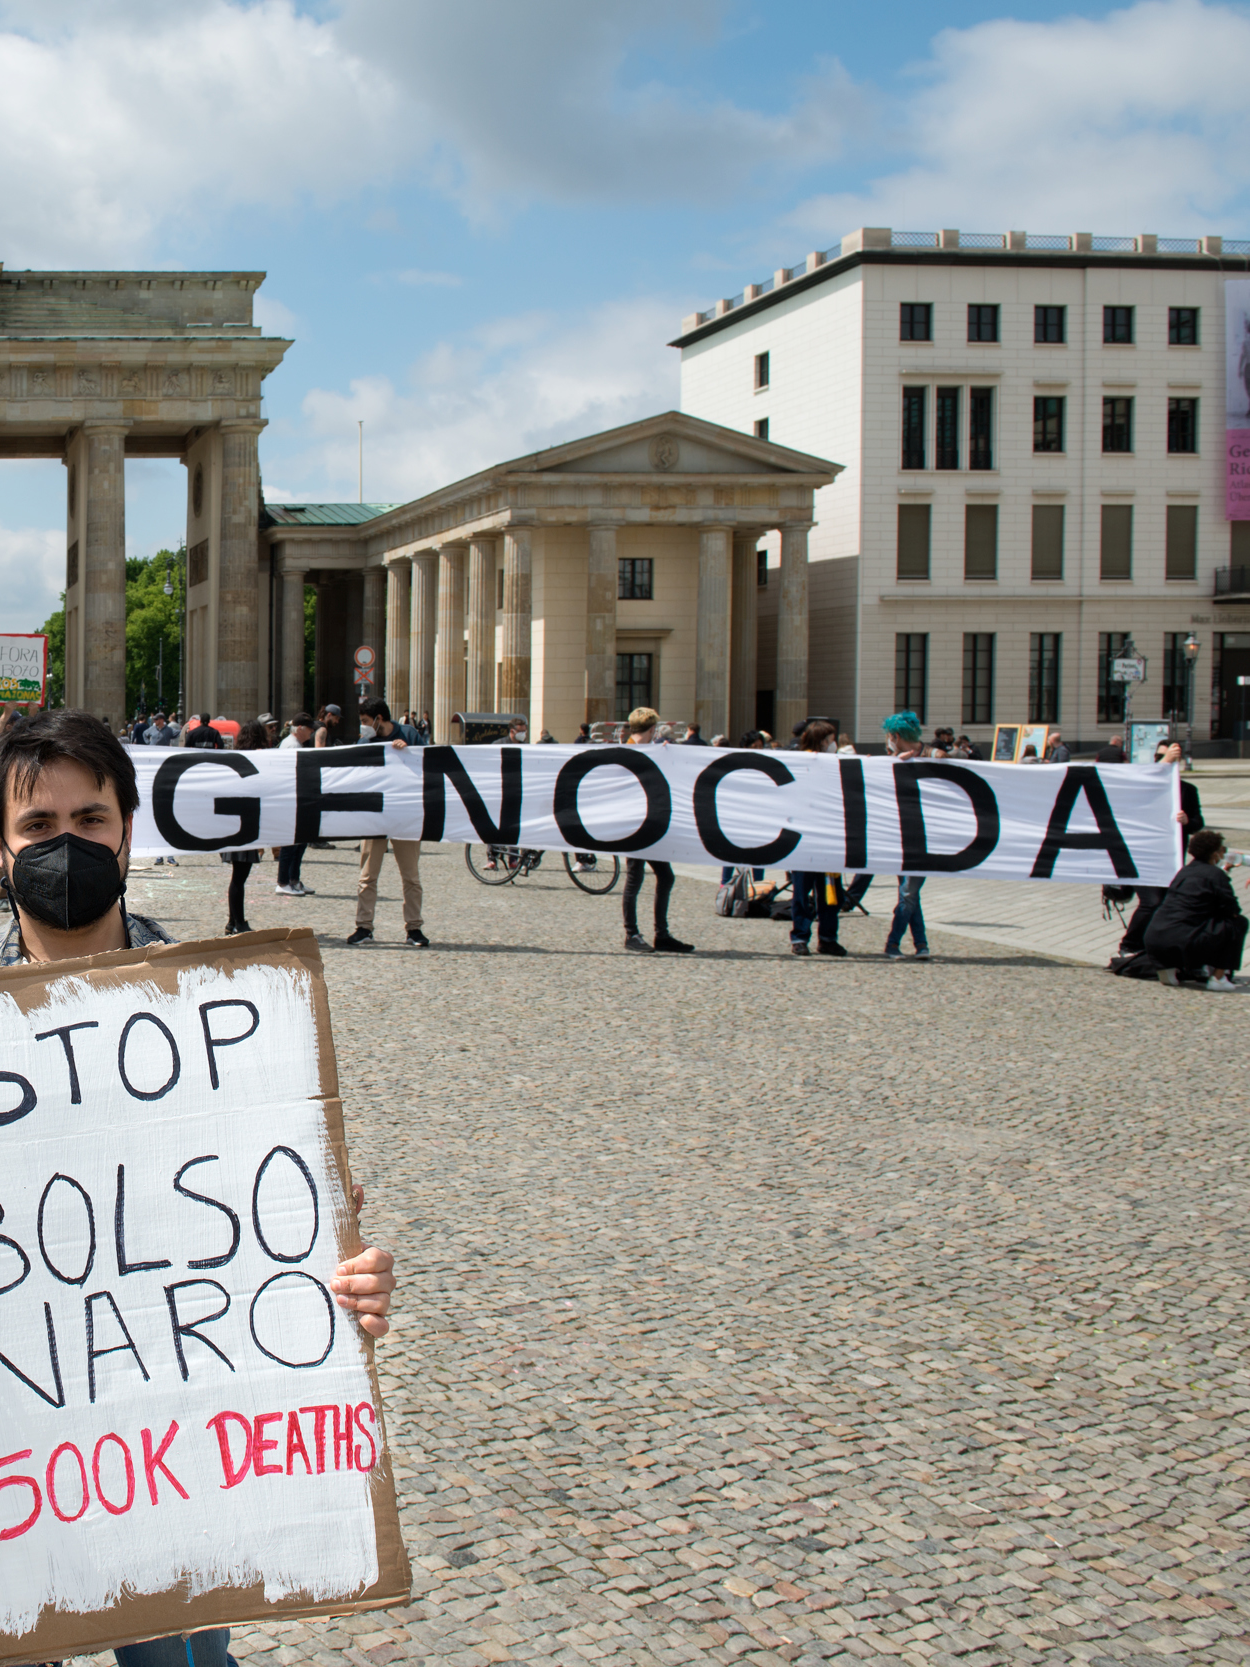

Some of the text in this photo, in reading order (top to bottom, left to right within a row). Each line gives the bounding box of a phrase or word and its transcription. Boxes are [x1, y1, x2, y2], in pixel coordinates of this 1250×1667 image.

[2, 664, 40, 678] BOZO
[152, 744, 1138, 879] GENOCIDA
[206, 1401, 378, 1490] DEATHS
